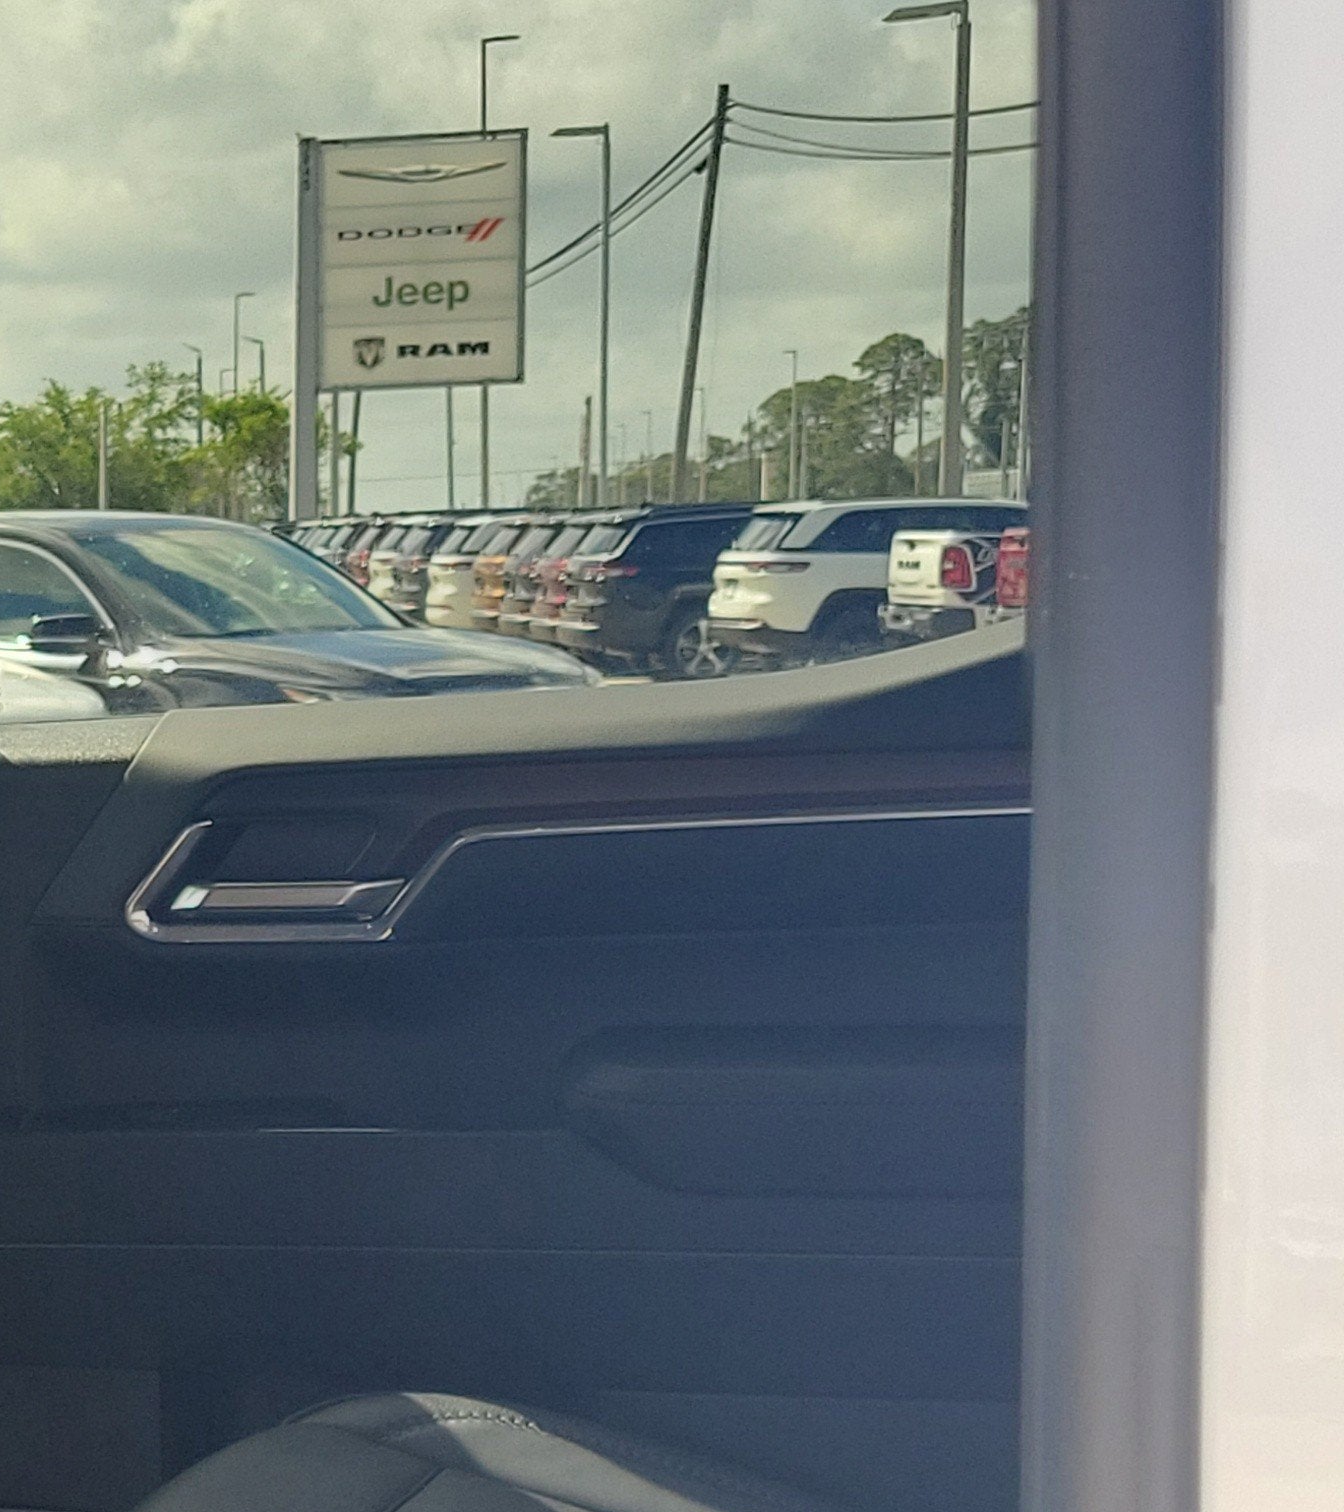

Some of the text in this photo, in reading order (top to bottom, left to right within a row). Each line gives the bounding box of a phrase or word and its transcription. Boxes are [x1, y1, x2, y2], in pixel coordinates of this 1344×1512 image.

[338, 223, 481, 241] DODGE
[373, 276, 470, 311] Jeep
[396, 341, 490, 359] RAM
